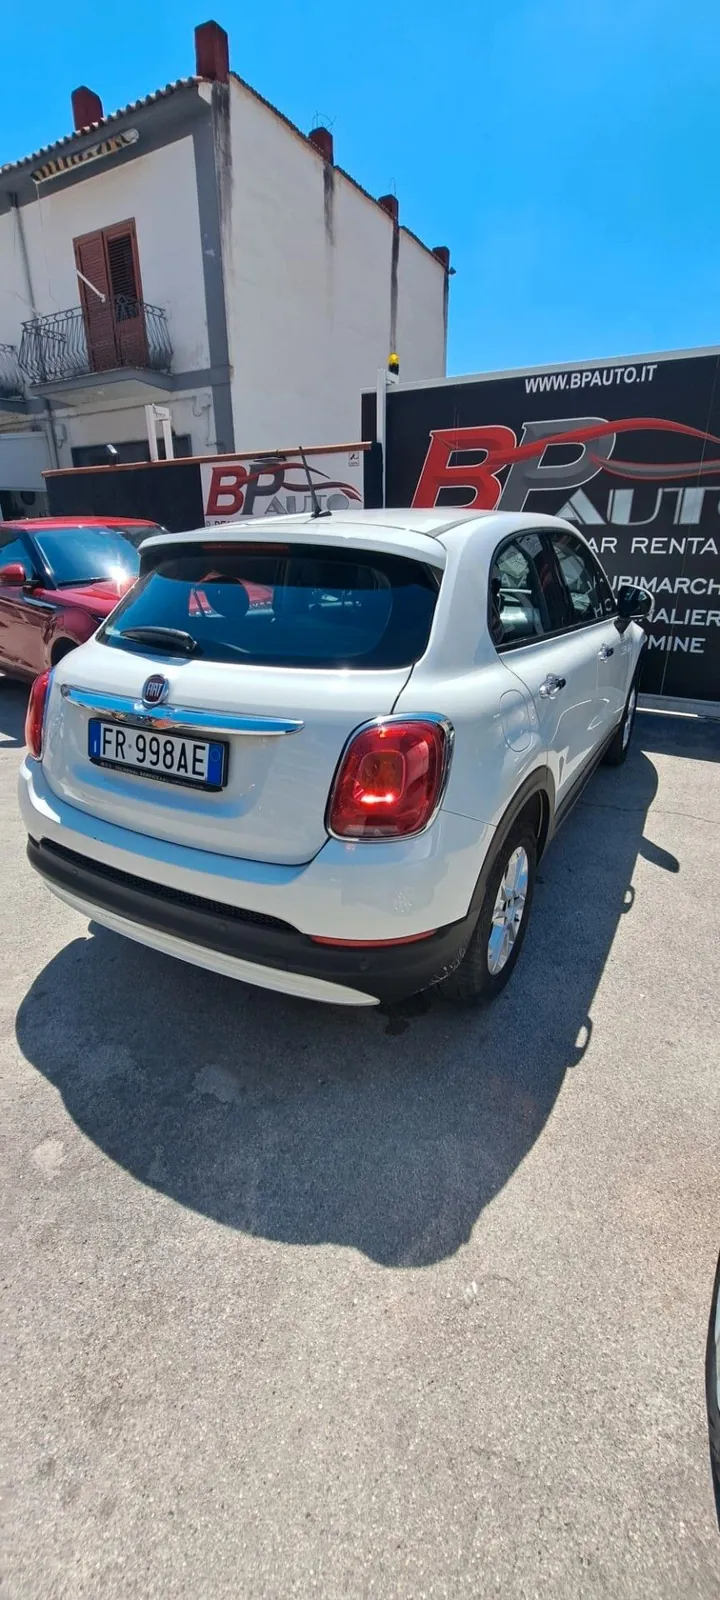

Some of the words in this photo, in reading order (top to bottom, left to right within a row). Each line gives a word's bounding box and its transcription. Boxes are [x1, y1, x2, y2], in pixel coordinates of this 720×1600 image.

[525, 364, 657, 394] WWW.BPAUTO.IT
[410, 416, 617, 512] BP
[205, 463, 285, 516] BP
[555, 486, 720, 526] AUT
[587, 537, 618, 554] AR
[631, 537, 720, 555] RENTA
[644, 634, 706, 654] MINE
[146, 682, 163, 697] FIAT
[102, 727, 126, 760] FR
[135, 734, 206, 777] 998AE
